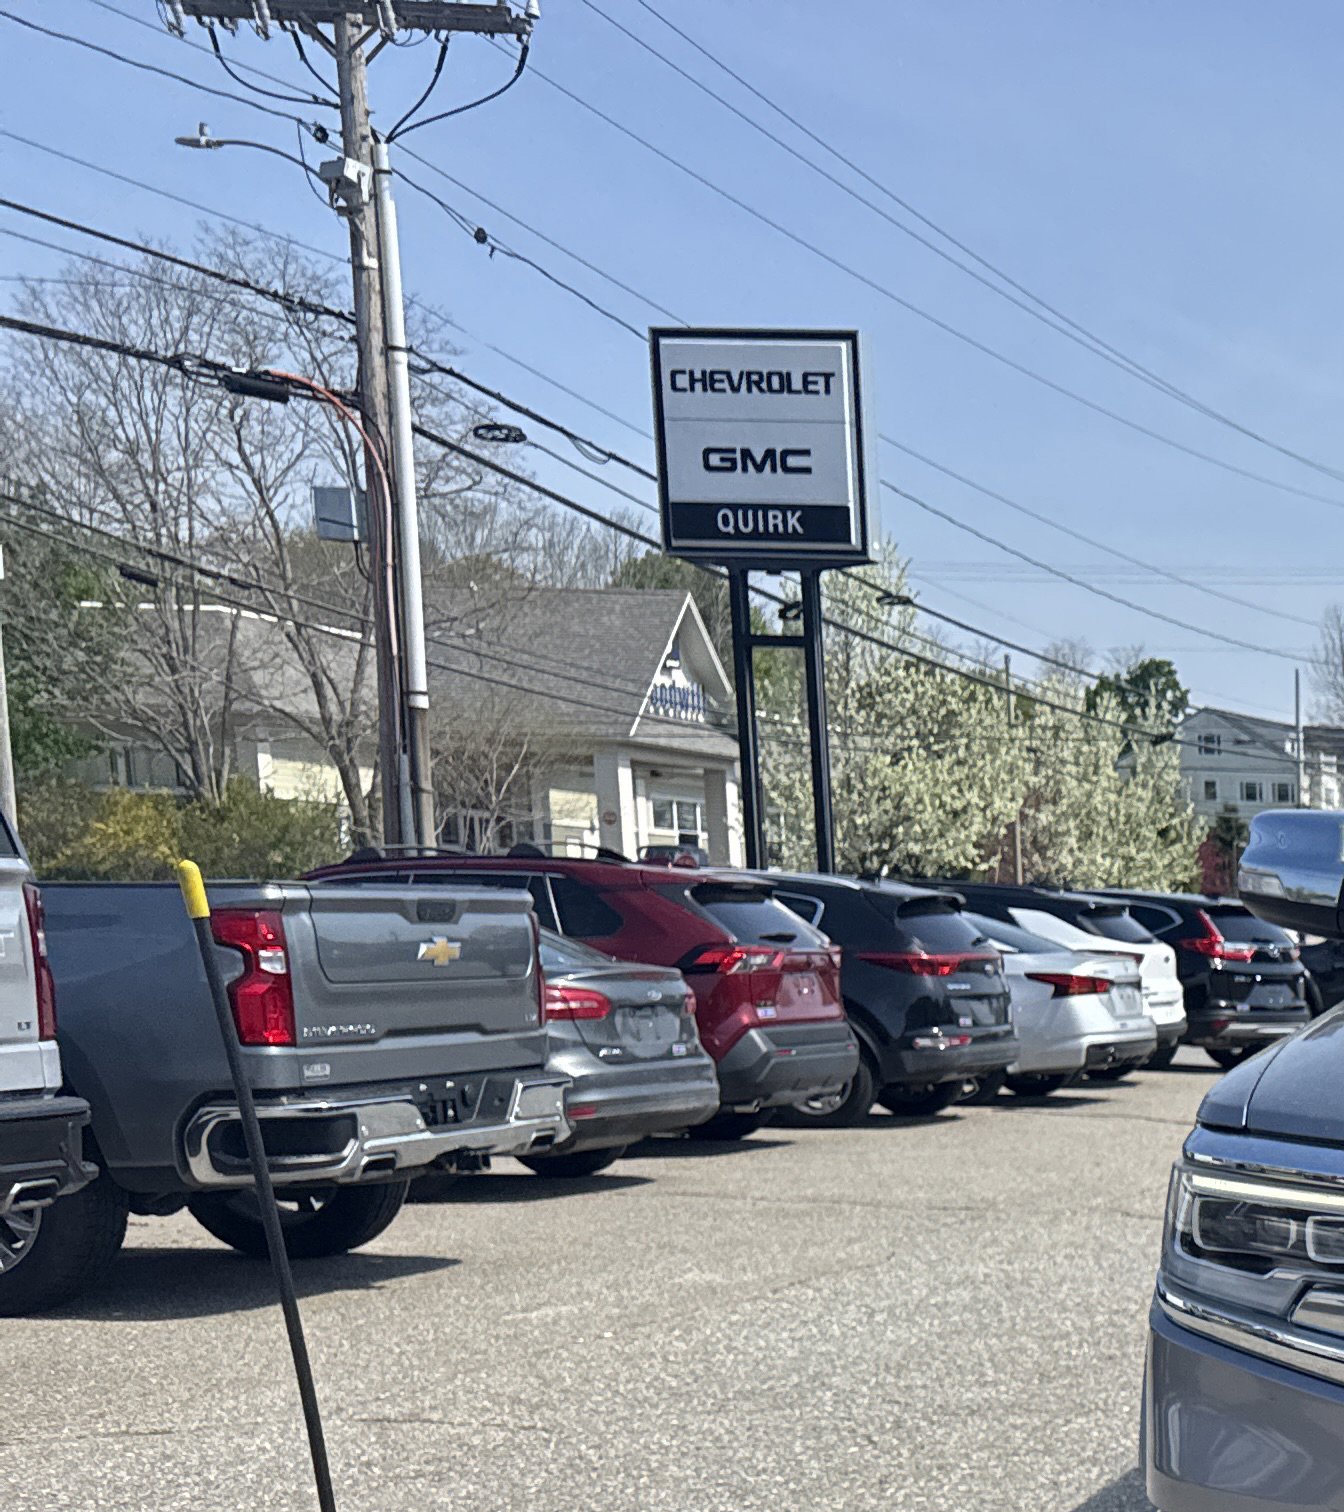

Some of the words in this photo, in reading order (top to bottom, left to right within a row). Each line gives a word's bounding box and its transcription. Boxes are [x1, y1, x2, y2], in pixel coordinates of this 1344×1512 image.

[669, 368, 836, 396] CHEVROLET
[702, 447, 812, 475] GMC
[717, 507, 804, 535] QUIRK
